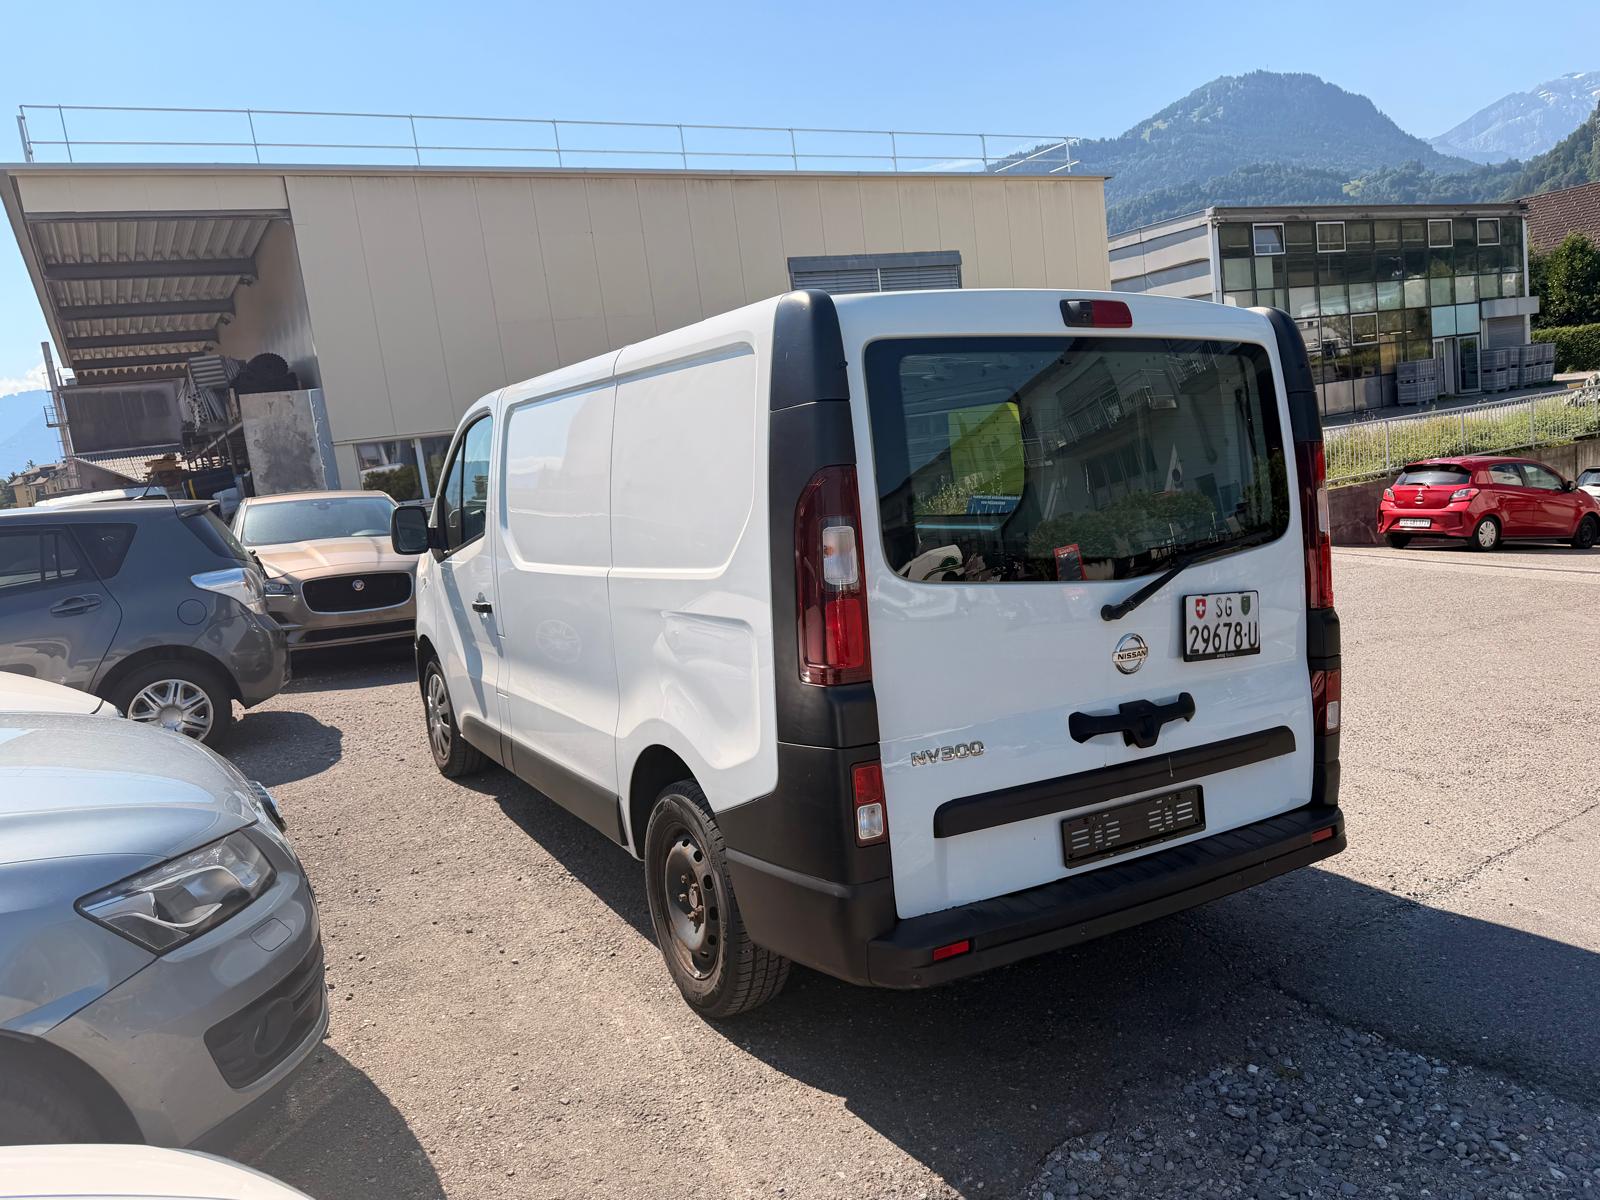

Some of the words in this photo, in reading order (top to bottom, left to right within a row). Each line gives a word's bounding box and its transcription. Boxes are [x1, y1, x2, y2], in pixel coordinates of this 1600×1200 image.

[1215, 597, 1233, 618] SG
[1117, 649, 1147, 660] NISSAN
[910, 740, 985, 767] NV300
